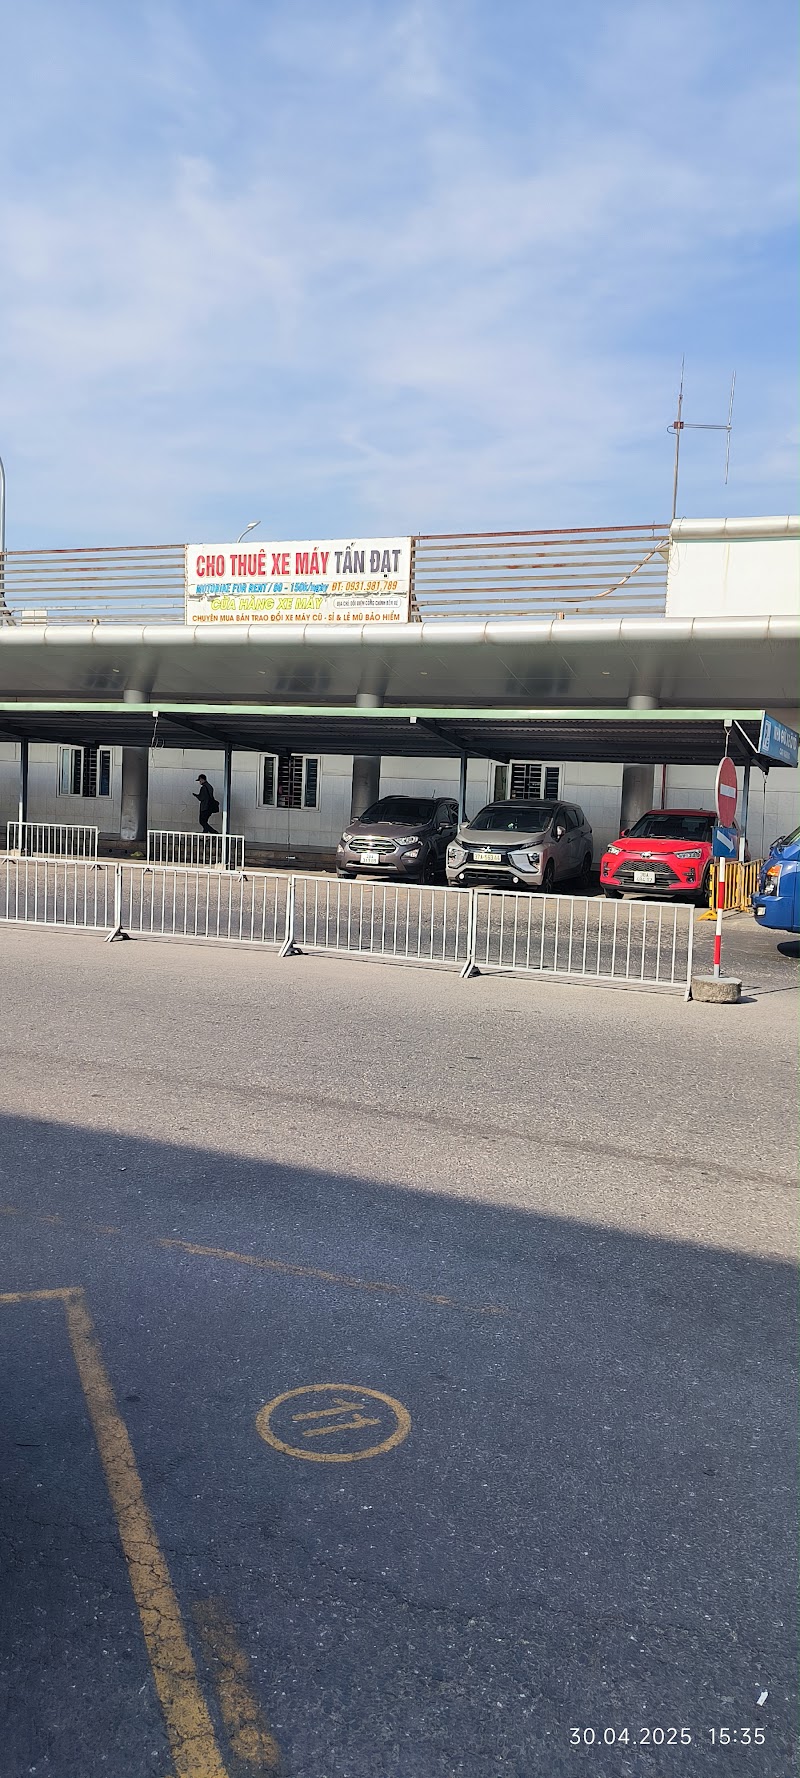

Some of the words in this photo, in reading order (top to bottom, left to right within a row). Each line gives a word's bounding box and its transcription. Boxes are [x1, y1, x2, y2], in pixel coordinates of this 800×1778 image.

[196, 555, 225, 577] CHO
[230, 549, 266, 576] THUÊ
[271, 553, 290, 575] XE
[295, 546, 330, 575] MÁY
[334, 542, 366, 574] TẤN
[369, 549, 401, 578] ĐẠT
[232, 583, 247, 593] FOR
[248, 583, 268, 592] RENT
[211, 595, 236, 610] CỬA
[239, 595, 275, 610] HÀNG
[276, 598, 294, 610] XE
[294, 595, 323, 610] MÁY
[192, 613, 218, 622] CHUYÊN
[236, 612, 250, 621] BÁN
[270, 611, 283, 621] ĐỔI
[295, 612, 310, 621] MÁY
[312, 613, 322, 621] CŨ
[365, 611, 380, 621] BẢO
[382, 610, 400, 621] HIỂM
